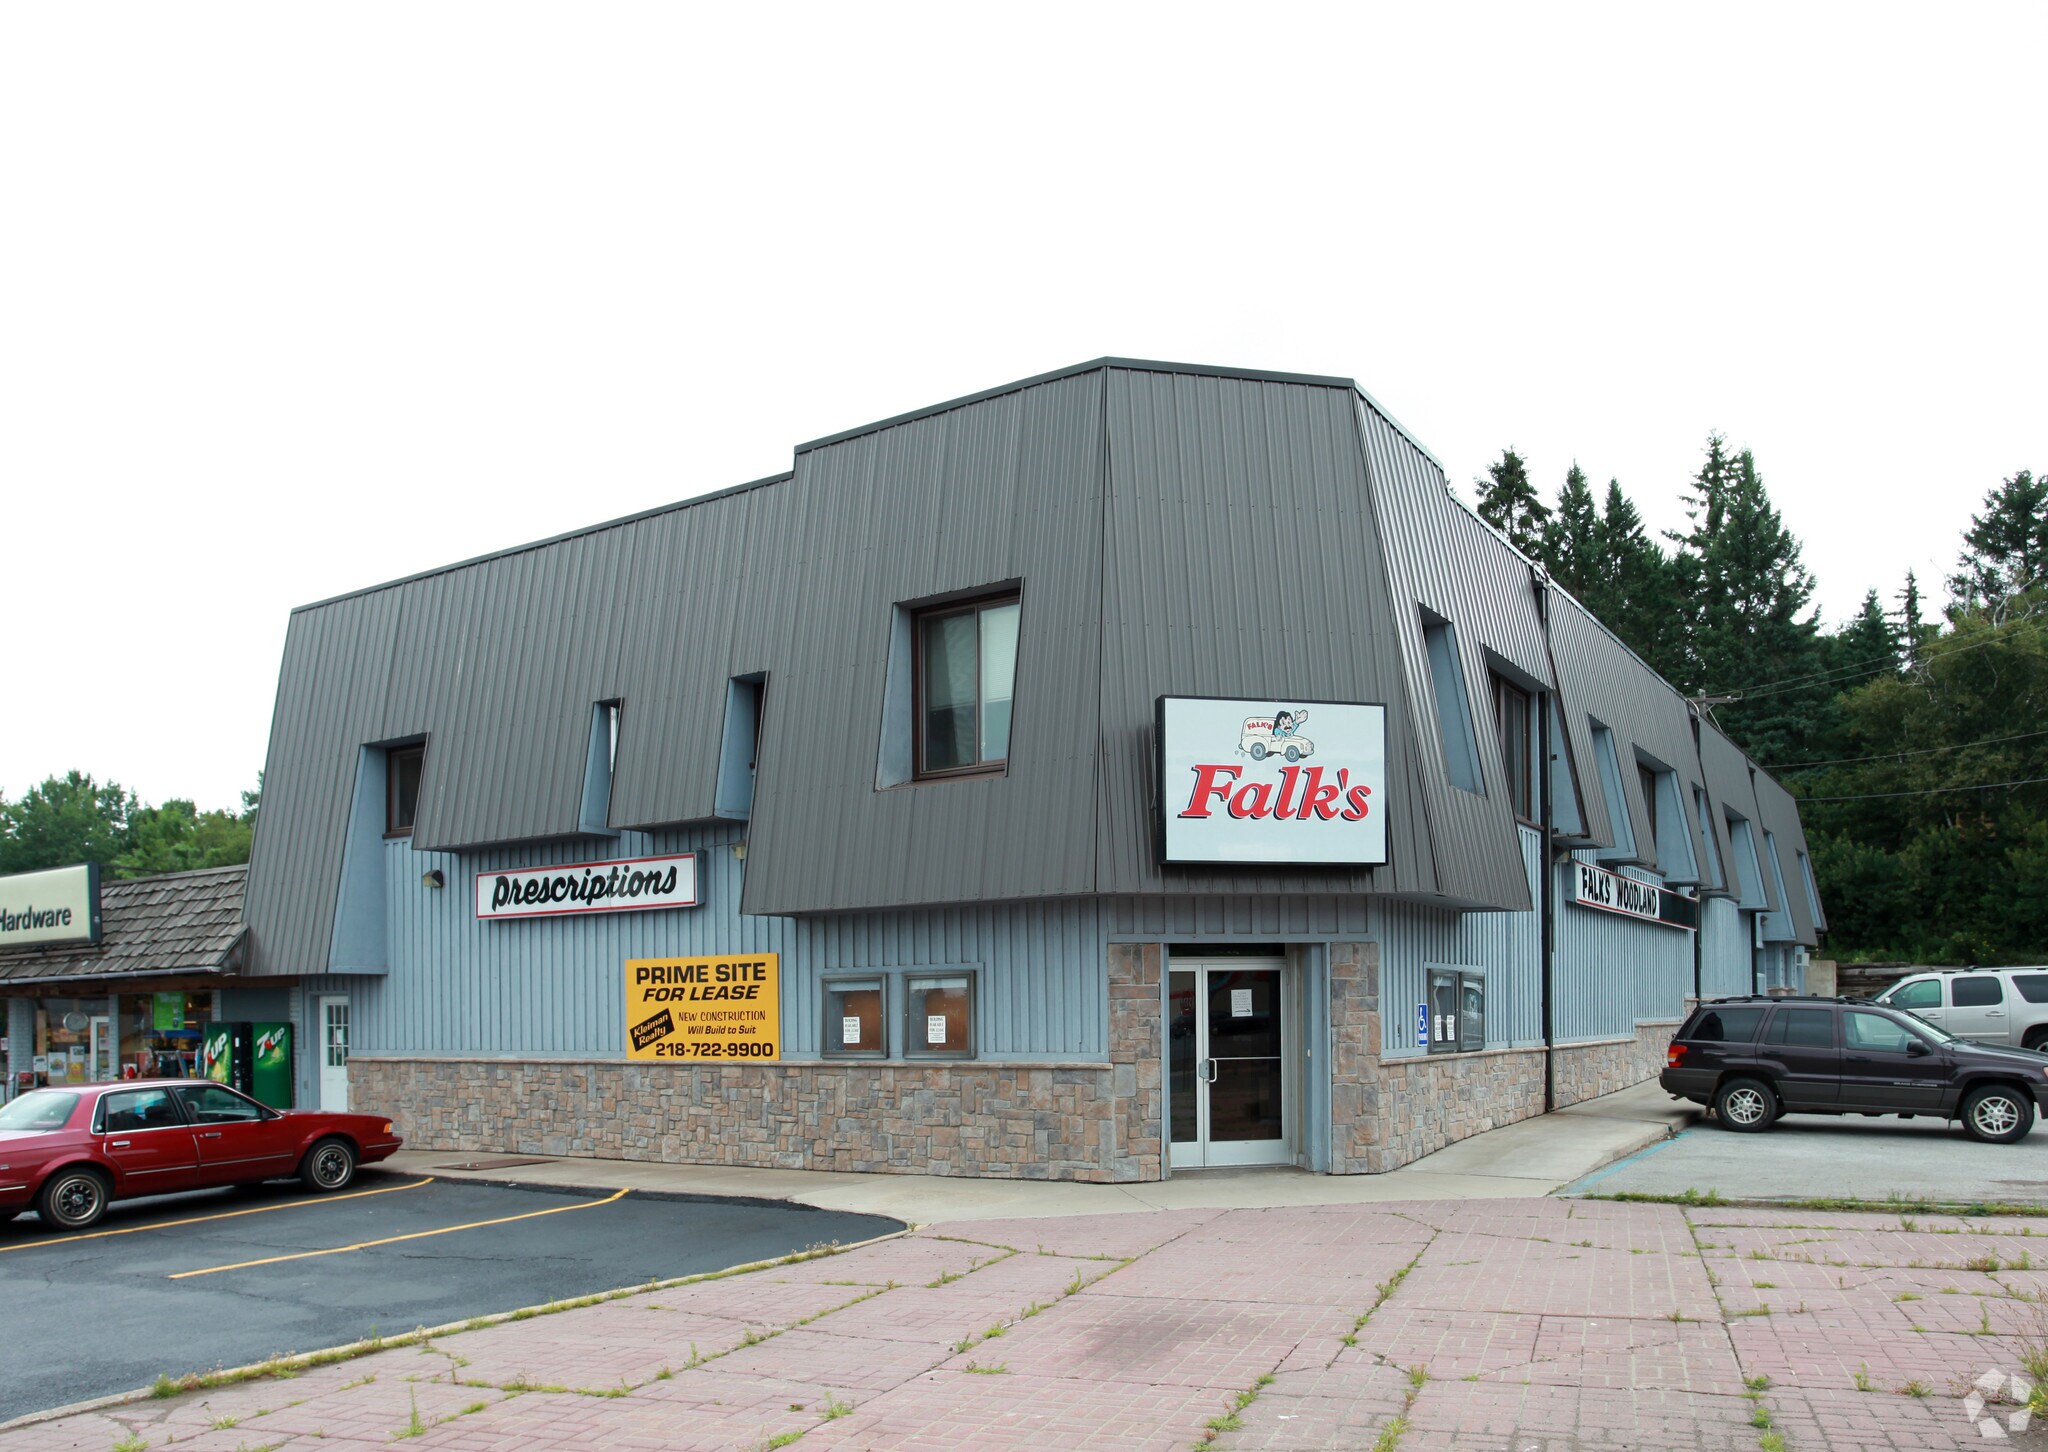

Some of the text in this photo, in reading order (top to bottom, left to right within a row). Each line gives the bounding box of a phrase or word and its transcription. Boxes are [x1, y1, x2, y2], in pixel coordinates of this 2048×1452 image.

[1177, 764, 1372, 822] Falk's
[1615, 877, 1657, 916] WOODLAND
[636, 962, 766, 985] PRIME SITE
[642, 985, 760, 1002] FOR LEASE
[678, 1010, 766, 1022] NEW CONSTRUCTION
[638, 1025, 667, 1046] Realty
[687, 1025, 757, 1035] Will Build to Suit
[655, 1042, 774, 1057] 218-722-9900
